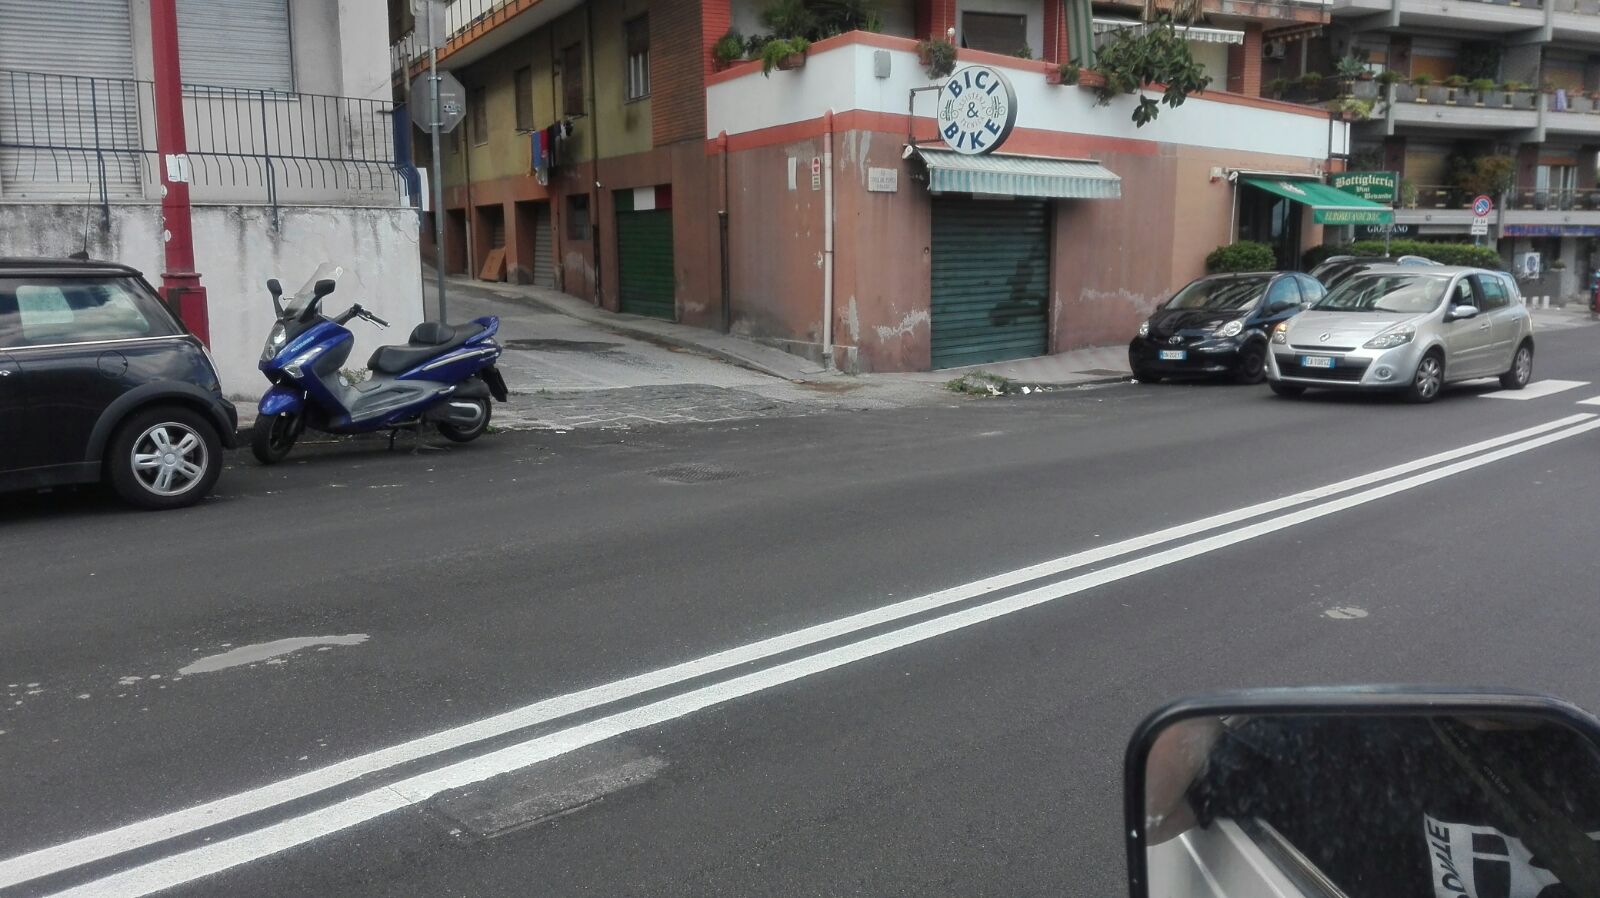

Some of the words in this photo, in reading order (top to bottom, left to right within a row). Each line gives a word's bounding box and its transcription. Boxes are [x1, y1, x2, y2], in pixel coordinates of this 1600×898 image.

[948, 71, 1000, 98] BICI
[967, 101, 979, 118] &
[944, 119, 1001, 149] BIKE
[1335, 174, 1394, 188] Bottiglieria
[1367, 224, 1409, 233] GIOANO
